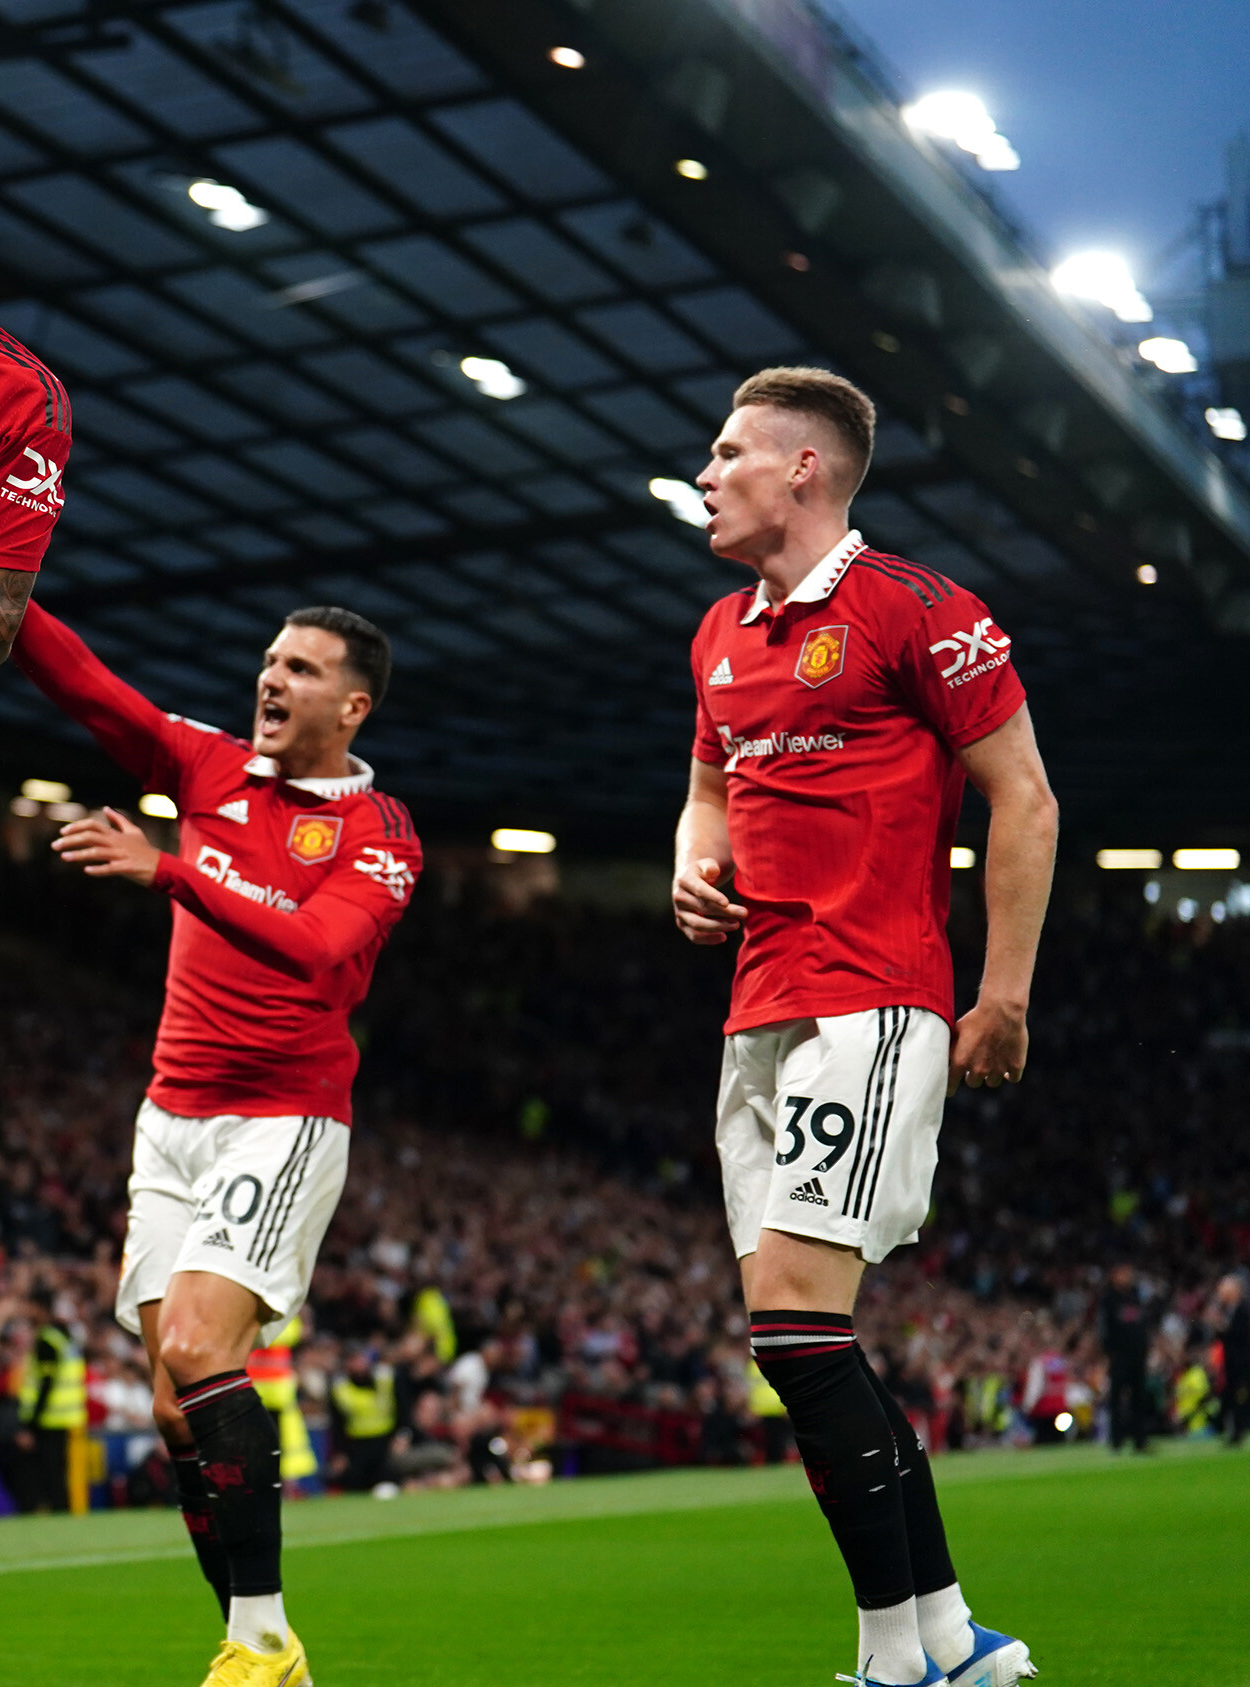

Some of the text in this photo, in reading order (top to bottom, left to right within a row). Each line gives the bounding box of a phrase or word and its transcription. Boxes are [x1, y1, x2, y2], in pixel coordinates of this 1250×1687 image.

[929, 617, 1011, 679] DXC
[734, 731, 846, 759] TeamViewer
[776, 1096, 855, 1173] 39
[790, 1191, 829, 1207] adidas
